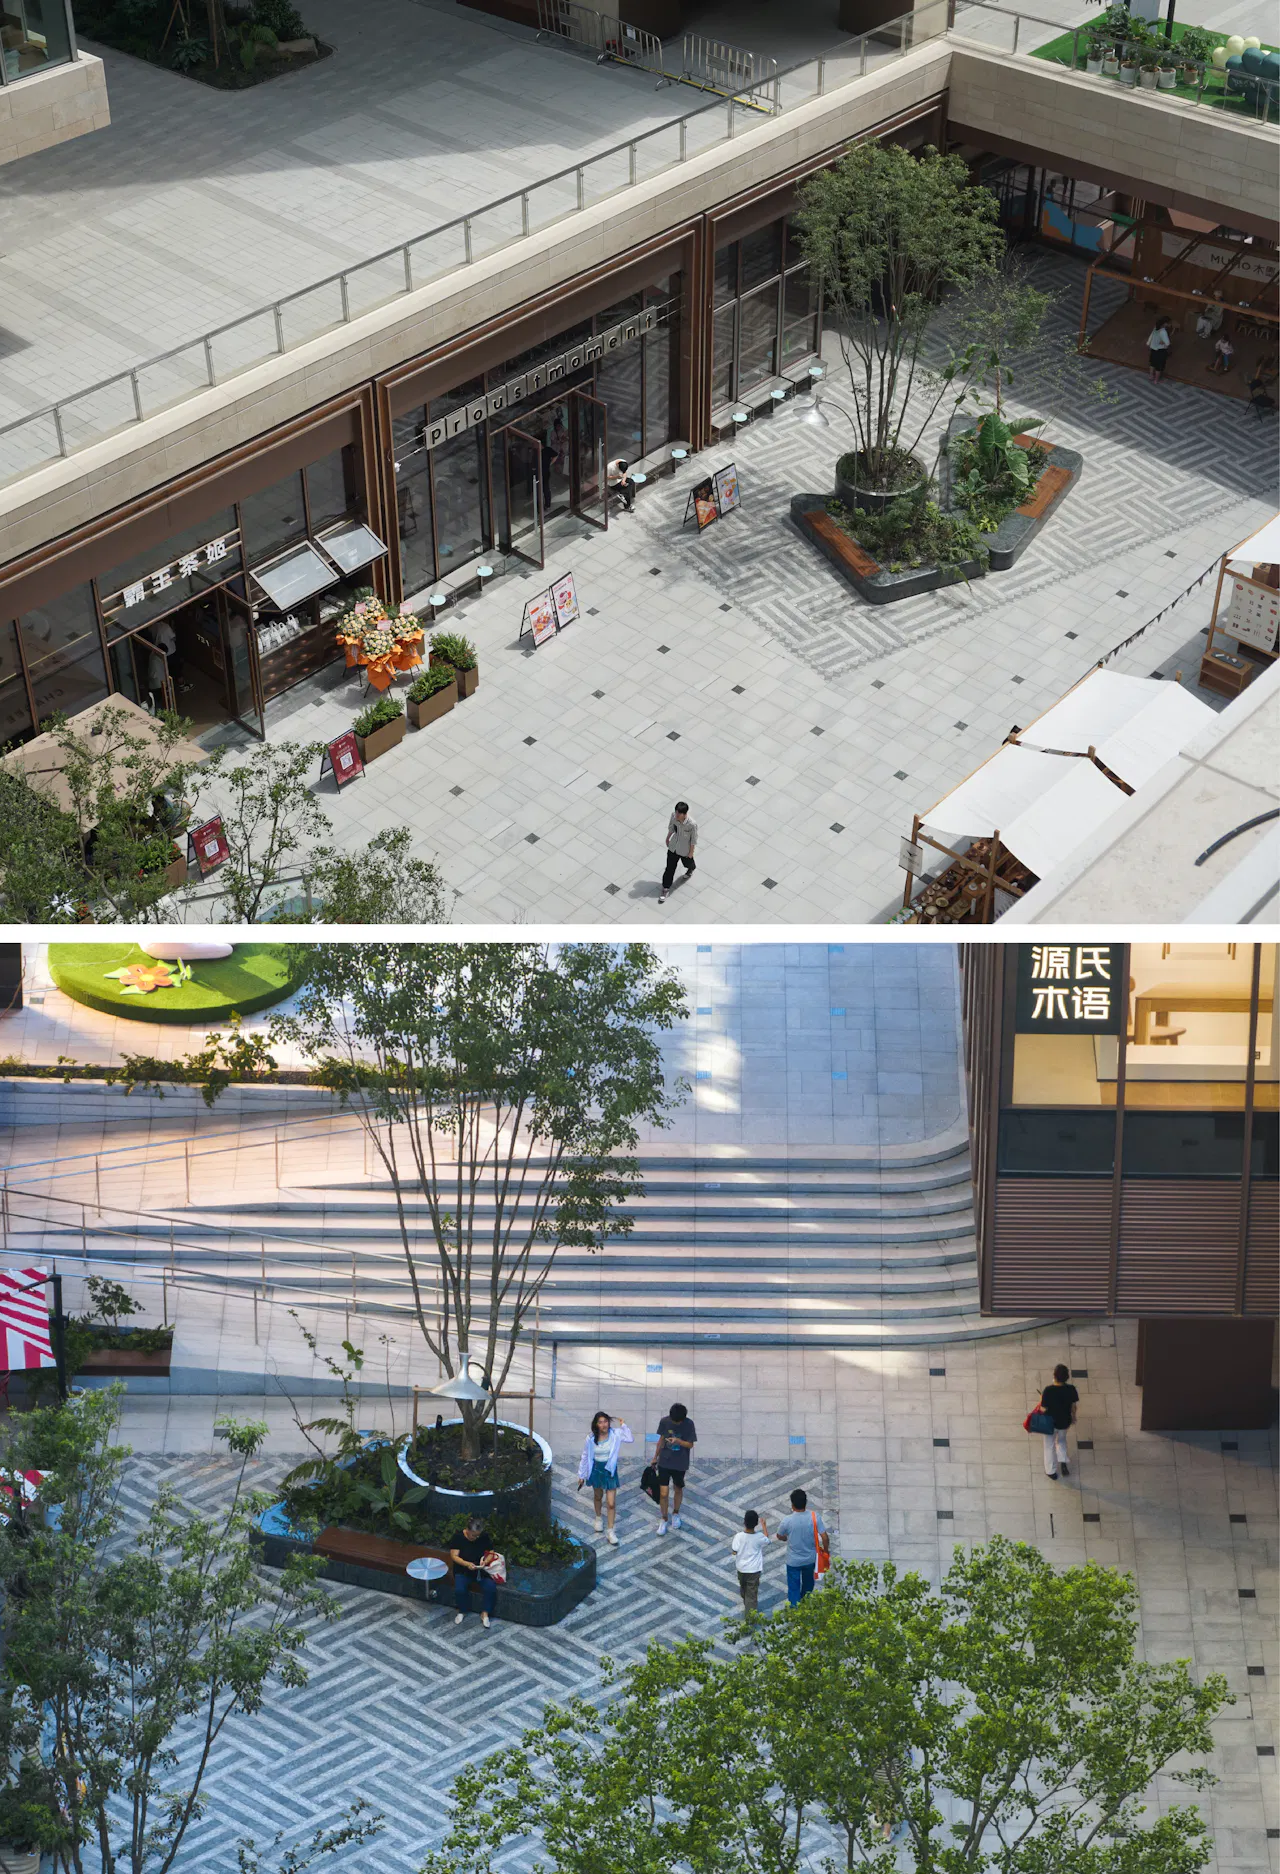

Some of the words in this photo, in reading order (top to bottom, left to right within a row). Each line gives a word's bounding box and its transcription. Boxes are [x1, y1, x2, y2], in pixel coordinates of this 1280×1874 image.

[431, 313, 654, 446] proustmoment
[123, 539, 228, 608] 霸王茶姬
[1032, 946, 1111, 980] 源氏
[1032, 986, 1111, 1021] 木语
